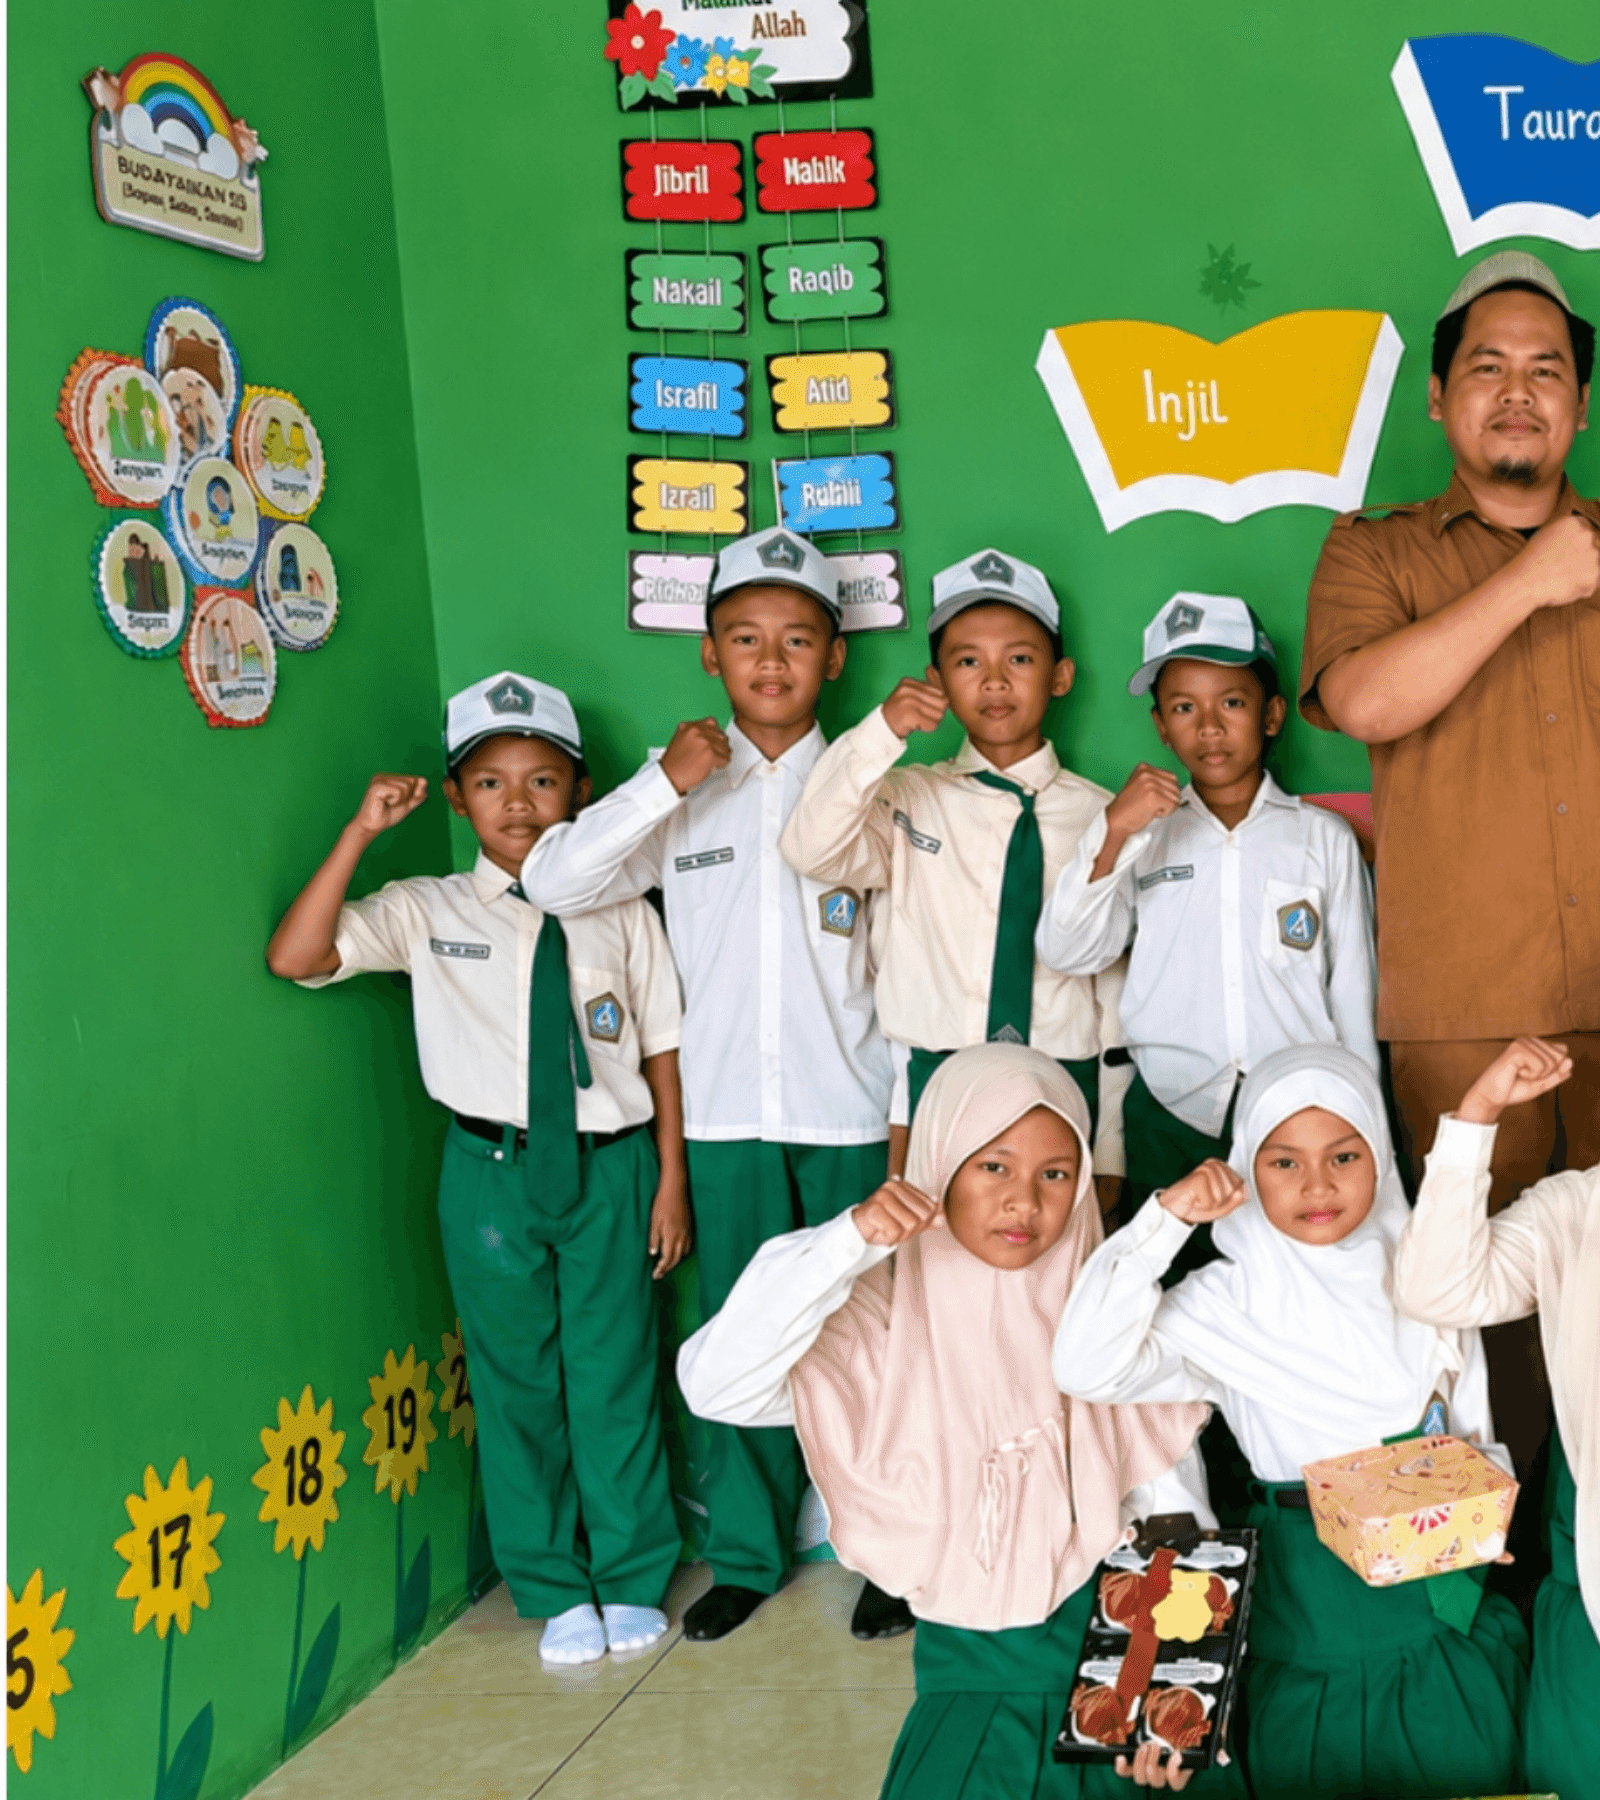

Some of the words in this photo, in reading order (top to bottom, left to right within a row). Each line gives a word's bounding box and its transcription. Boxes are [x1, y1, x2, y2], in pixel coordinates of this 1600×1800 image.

[752, 11, 807, 39] Allah
[654, 163, 709, 197] Jibril
[789, 264, 854, 295] Raqib
[655, 379, 719, 411] Israfil
[807, 376, 850, 405] Atid
[1143, 369, 1229, 441] Injil
[660, 482, 716, 510] Izrail
[383, 1386, 418, 1455] 19
[283, 1436, 324, 1506] 18
[147, 1513, 192, 1589] 17
